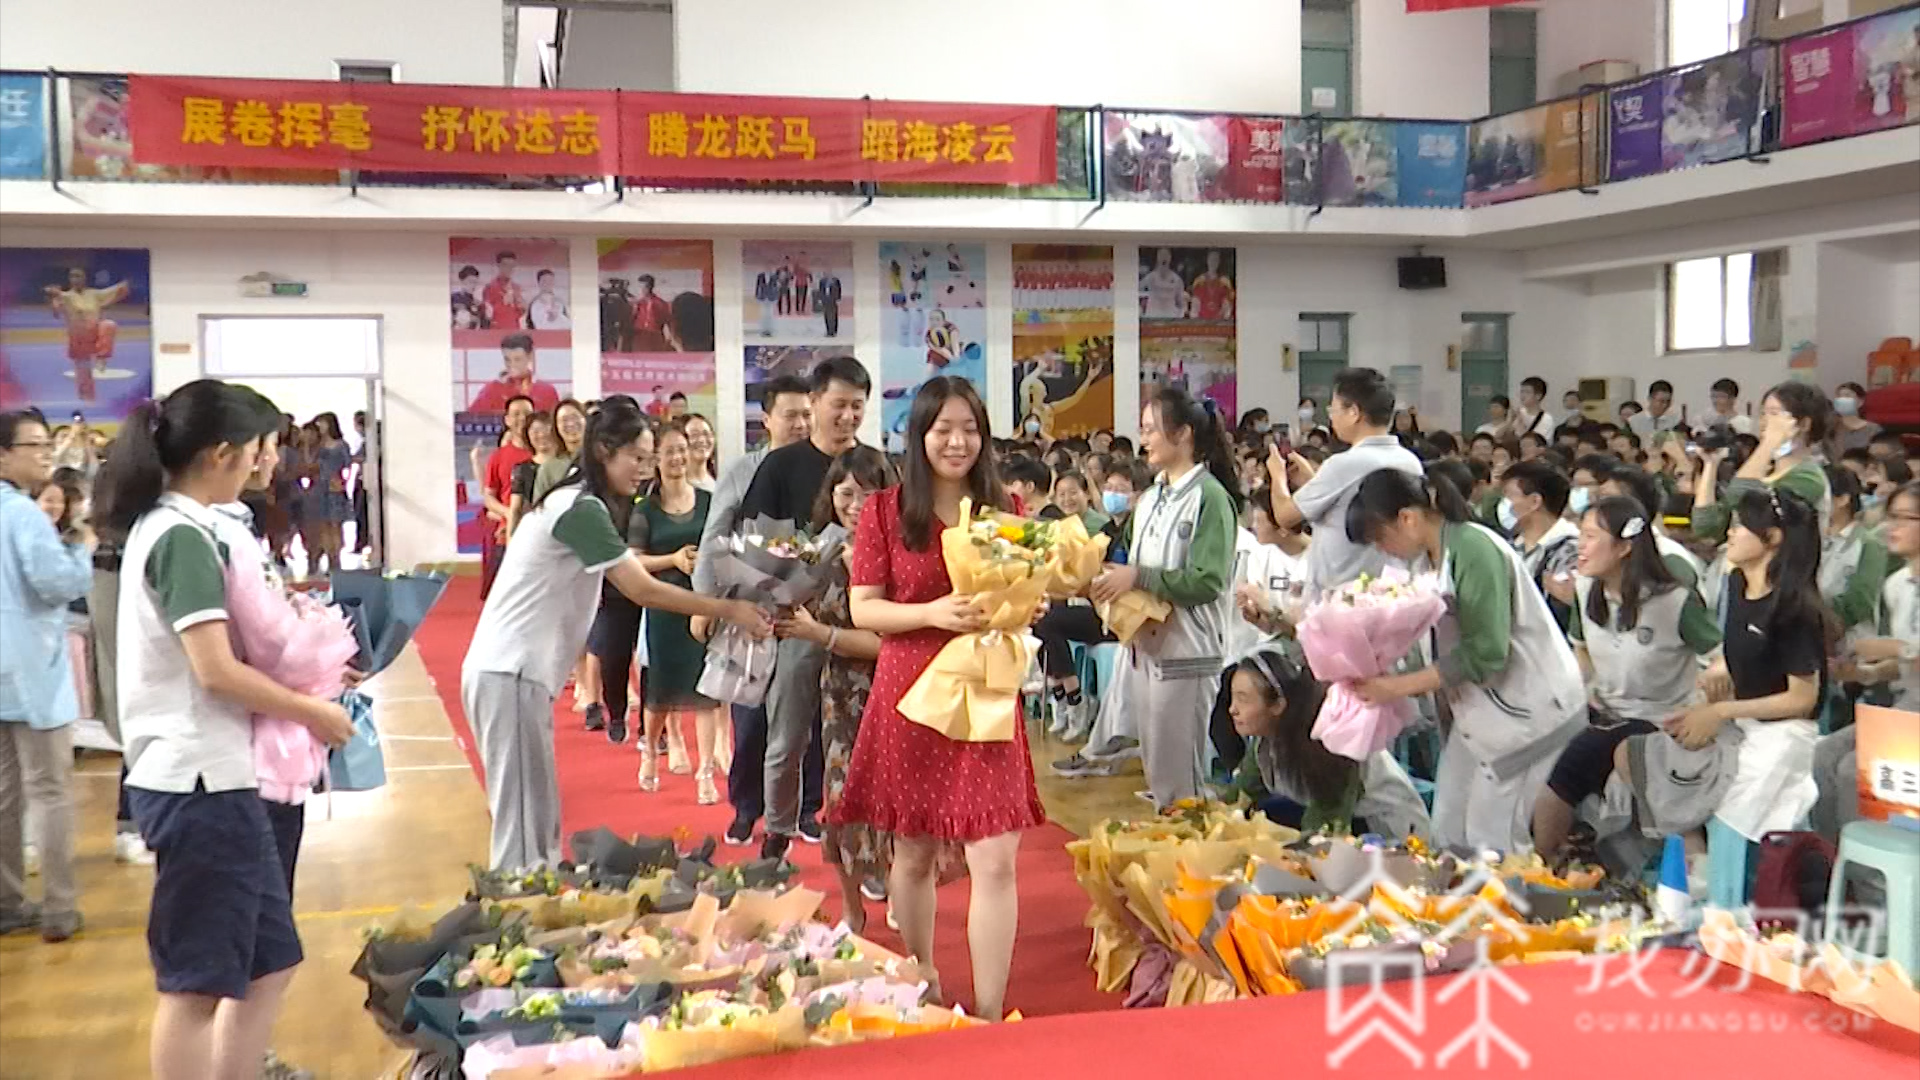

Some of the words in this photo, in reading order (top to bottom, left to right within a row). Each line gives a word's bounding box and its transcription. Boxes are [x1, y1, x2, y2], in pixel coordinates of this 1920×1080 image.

[182, 97, 372, 151] 展卷挥毫
[421, 105, 601, 155] 抒怀述志
[648, 111, 817, 161] 腾龙跃马
[861, 119, 1017, 164] 蹈海凌云
